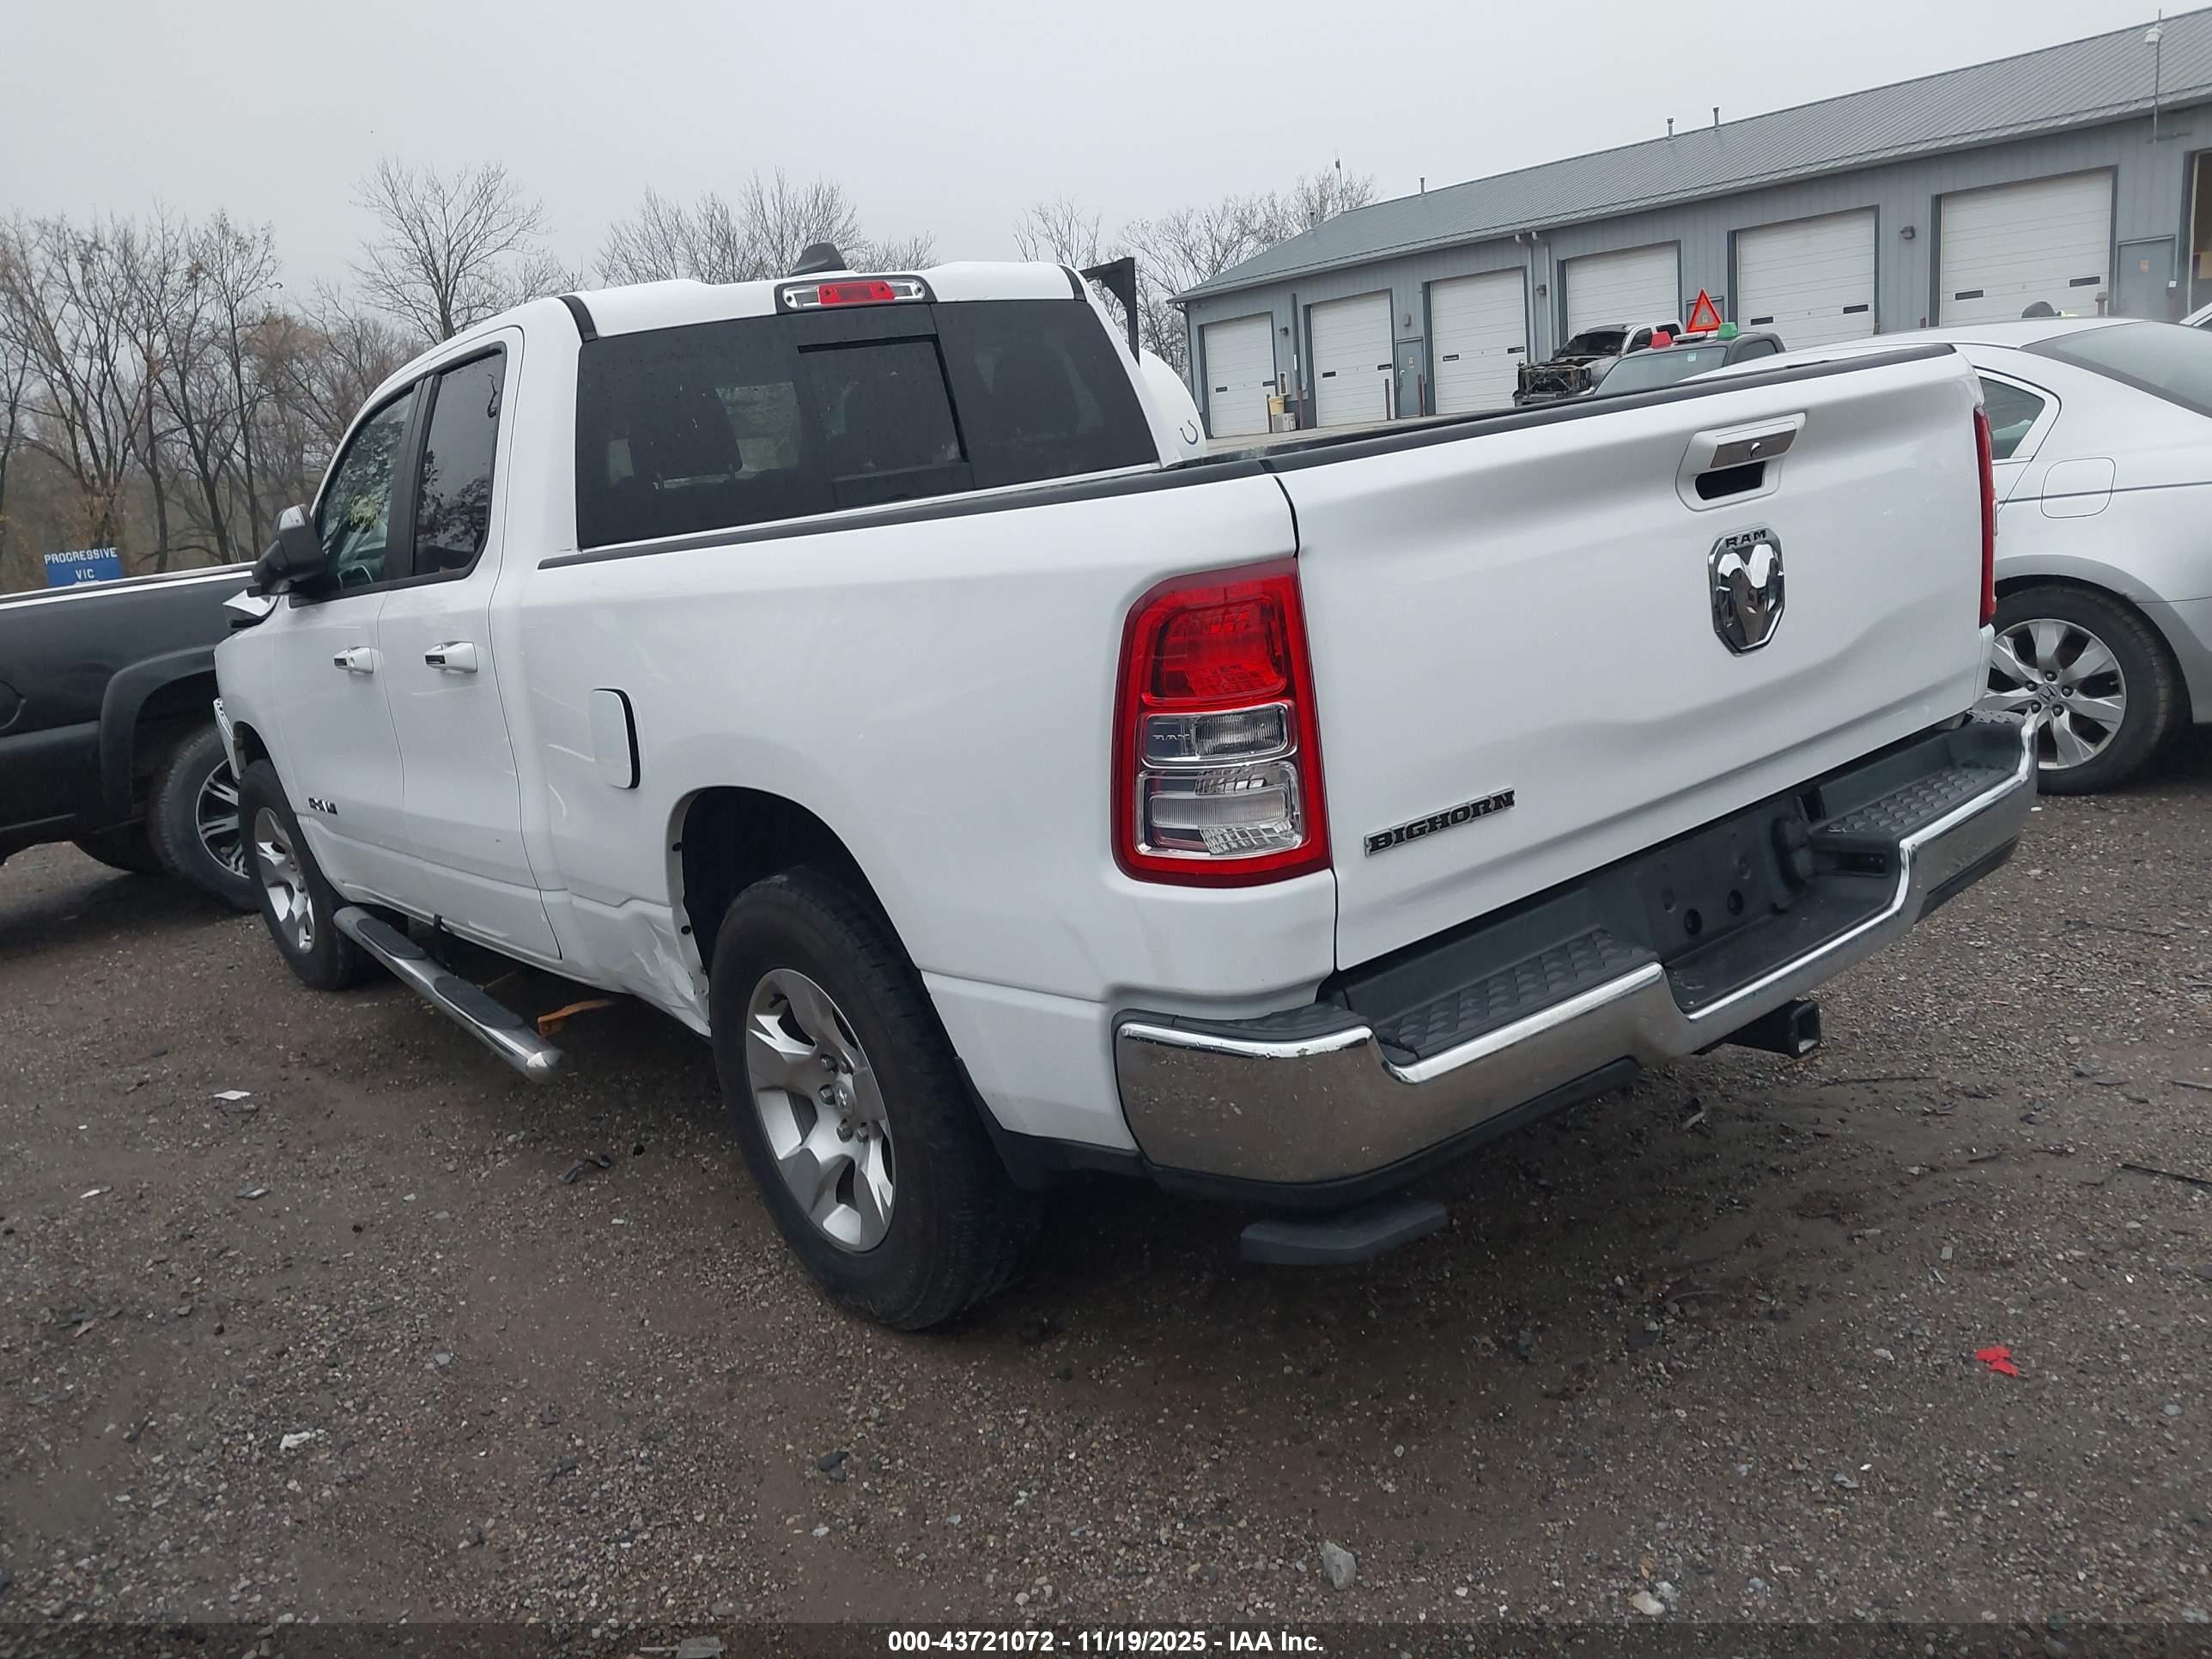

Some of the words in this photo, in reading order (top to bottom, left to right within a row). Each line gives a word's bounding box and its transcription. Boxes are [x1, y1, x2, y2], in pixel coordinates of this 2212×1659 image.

[1726, 529, 1767, 549] RAM
[44, 547, 118, 564] PROGRESSIVE
[76, 568, 95, 580] VIC
[1365, 787, 1515, 855] BIGHORN
